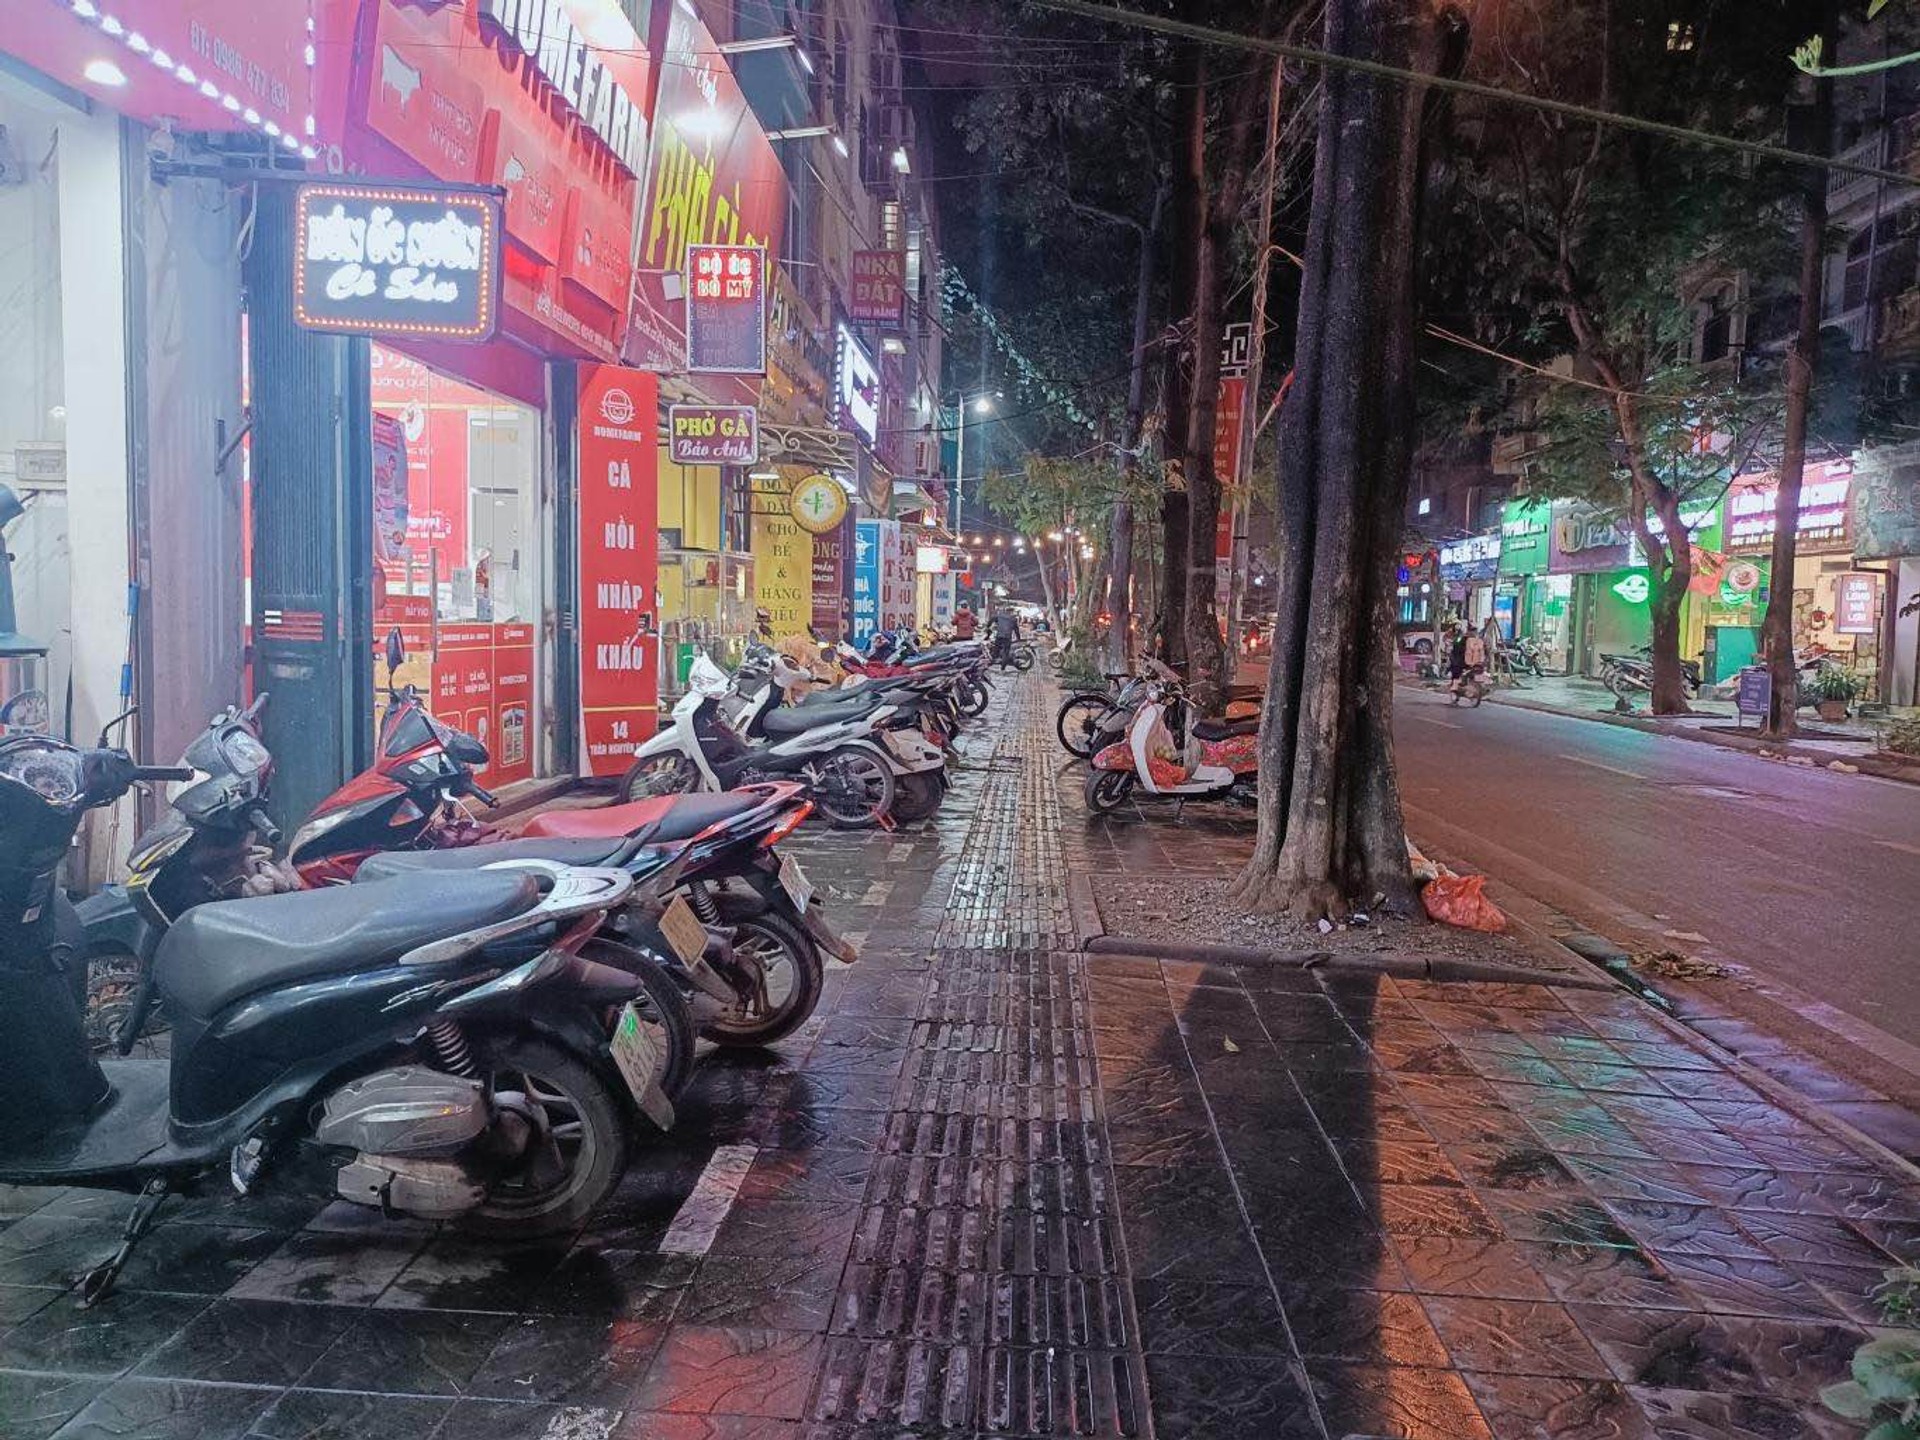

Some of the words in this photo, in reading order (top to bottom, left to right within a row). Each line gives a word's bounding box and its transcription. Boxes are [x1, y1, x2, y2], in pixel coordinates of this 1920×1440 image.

[675, 410, 716, 436] PHỞ
[720, 413, 750, 437] GÀ
[712, 440, 752, 459] Anh
[607, 458, 632, 489] CÁ
[767, 523, 798, 536] CHO
[773, 541, 791, 557] BÉ
[777, 565, 788, 579] &
[597, 579, 643, 614] NHẬP
[611, 720, 629, 740] 14
